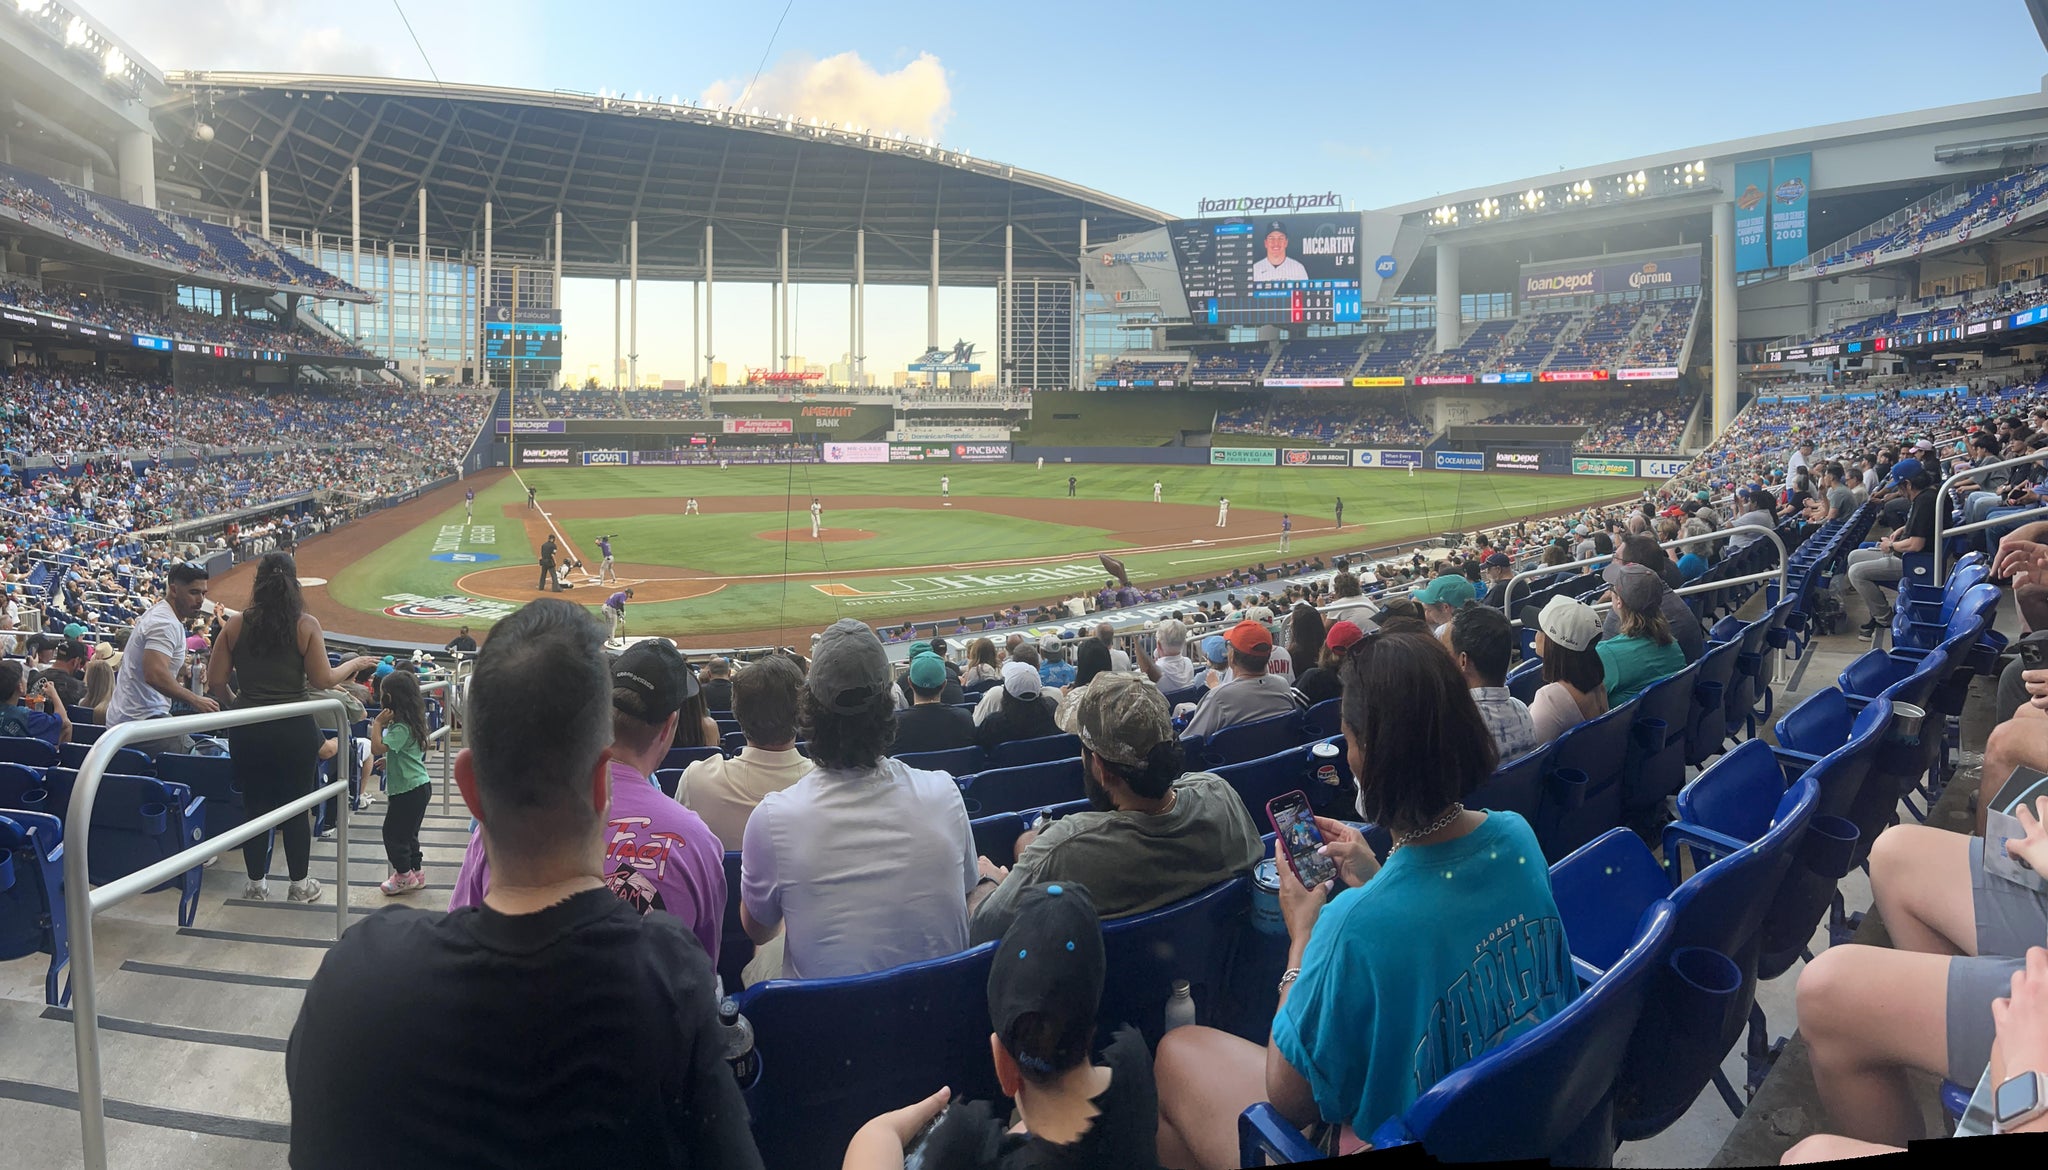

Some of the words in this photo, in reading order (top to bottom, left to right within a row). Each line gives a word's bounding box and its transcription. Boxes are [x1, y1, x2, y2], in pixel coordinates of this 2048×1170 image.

[1201, 194, 1293, 213] loanDepot
[1295, 191, 1336, 213] park
[1773, 212, 1789, 221] WORLD
[1790, 211, 1805, 219] SERIES
[1776, 229, 1802, 240] 2003
[1741, 235, 1760, 245] 1997
[1303, 237, 1355, 255] MCCARTHY
[1336, 256, 1343, 266] LF
[1527, 271, 1593, 291] loanDepot
[1629, 271, 1672, 288] Corona
[514, 311, 550, 319] antaloupe
[1428, 375, 1467, 384] Multinational
[801, 406, 853, 417] AMERANT
[513, 421, 549, 429] oanDepot
[816, 419, 840, 427] BANK
[523, 448, 569, 457] loanDepot
[591, 453, 620, 462] GOYA
[1496, 452, 1539, 463] loanDepot
[606, 816, 686, 881] FAST
[1475, 913, 1525, 953] FLORIDA
